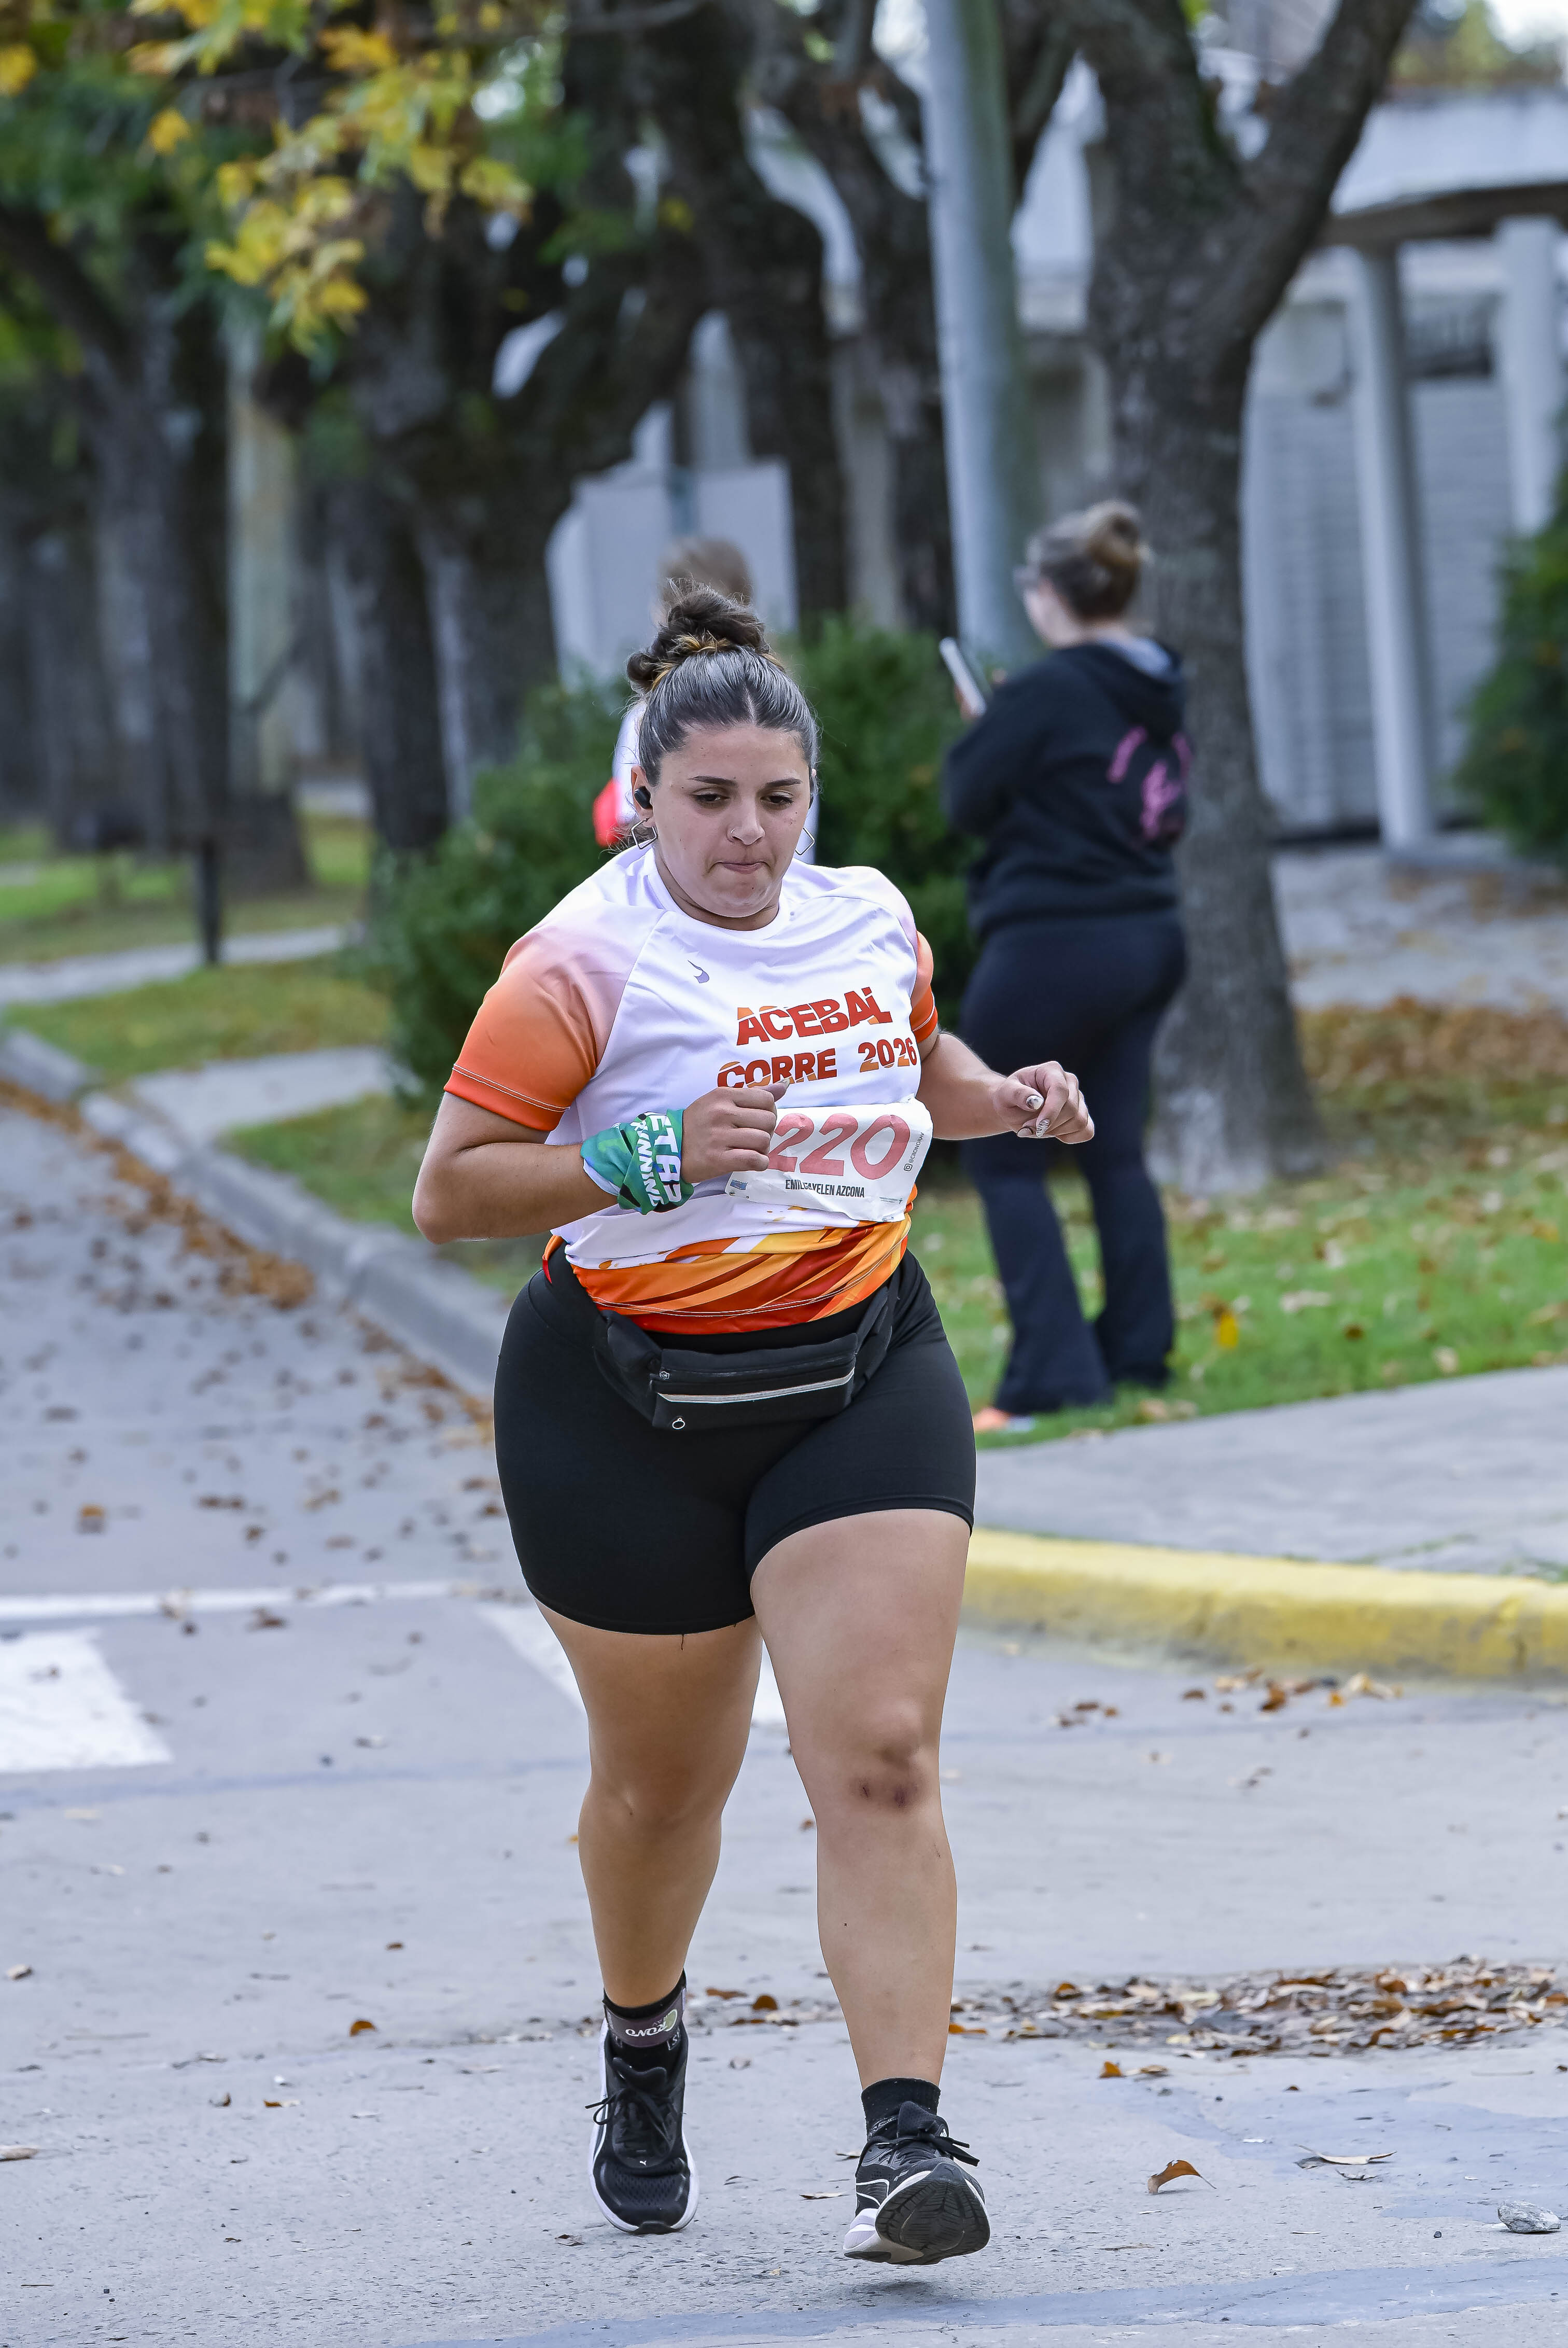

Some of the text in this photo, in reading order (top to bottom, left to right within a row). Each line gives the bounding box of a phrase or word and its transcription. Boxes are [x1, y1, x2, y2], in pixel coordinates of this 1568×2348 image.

[718, 1038, 917, 1088] CORRE 2026
[630, 1120, 664, 1207] RUNNING
[767, 1113, 911, 1180] 220
[835, 1185, 865, 1198] AZCONA
